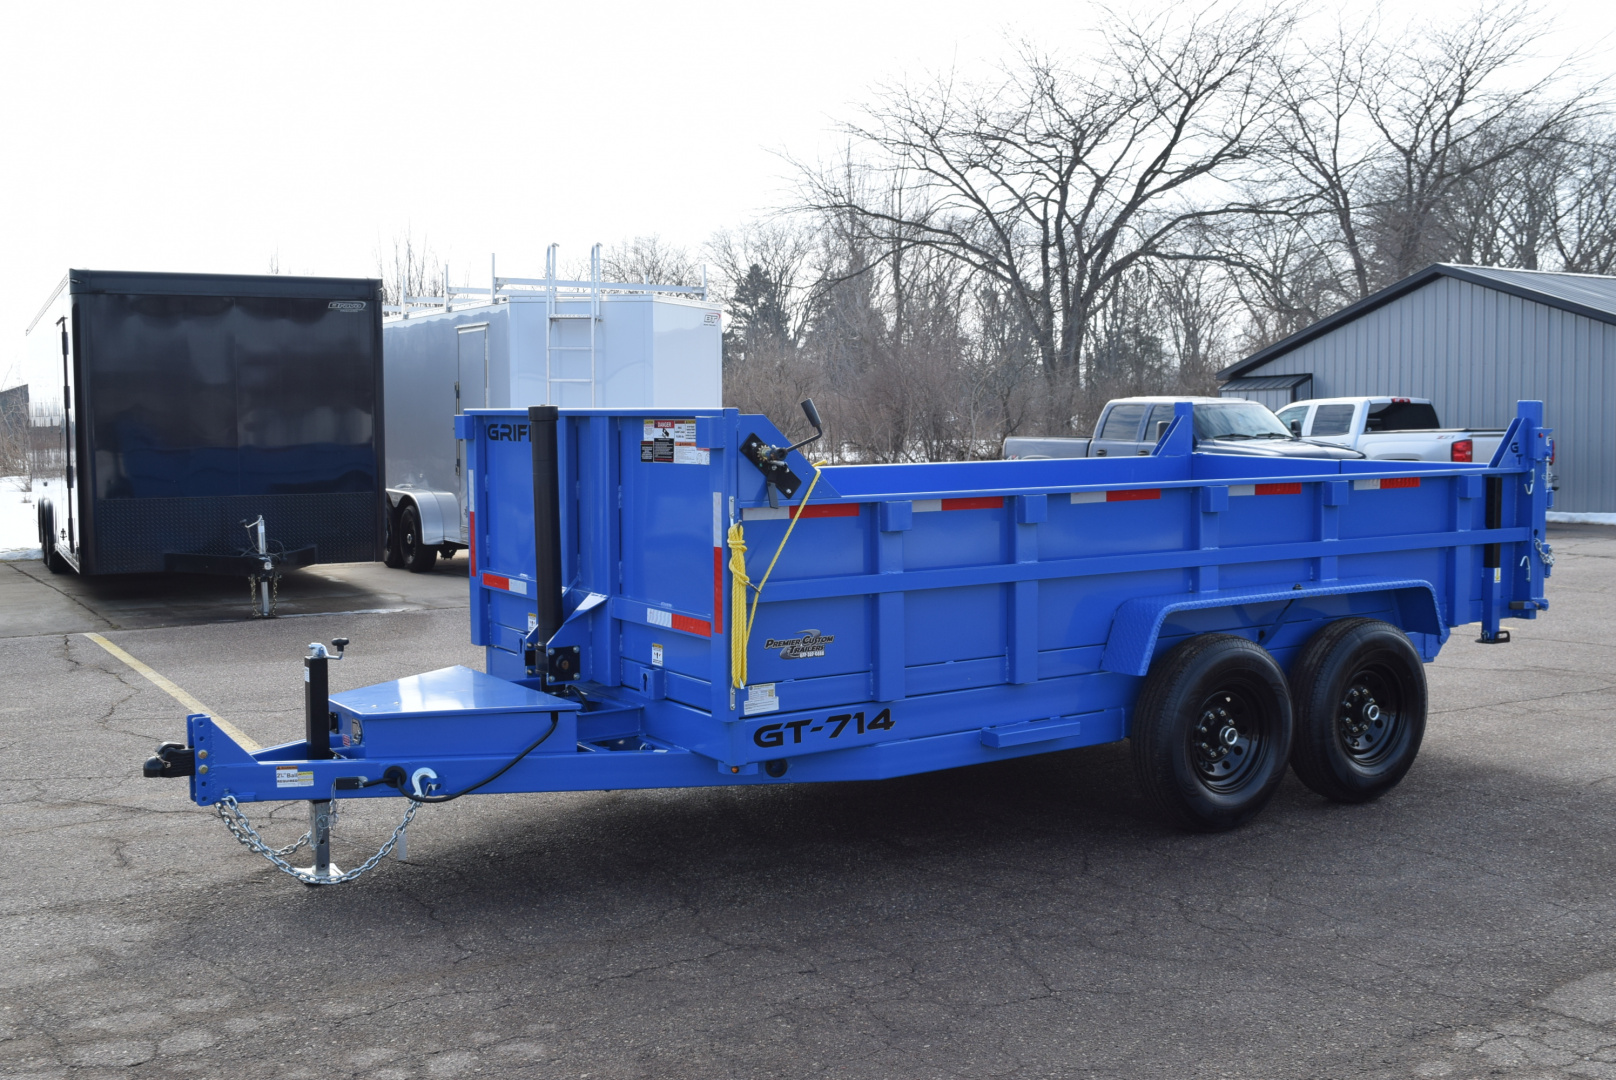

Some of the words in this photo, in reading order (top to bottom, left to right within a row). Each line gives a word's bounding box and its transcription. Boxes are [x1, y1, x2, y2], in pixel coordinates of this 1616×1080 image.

[487, 423, 532, 442] GRIF
[765, 638, 801, 649] PREMIER
[802, 635, 834, 645] CUSTOM
[789, 645, 824, 654] TRAILERS
[753, 708, 896, 748] GT-714
